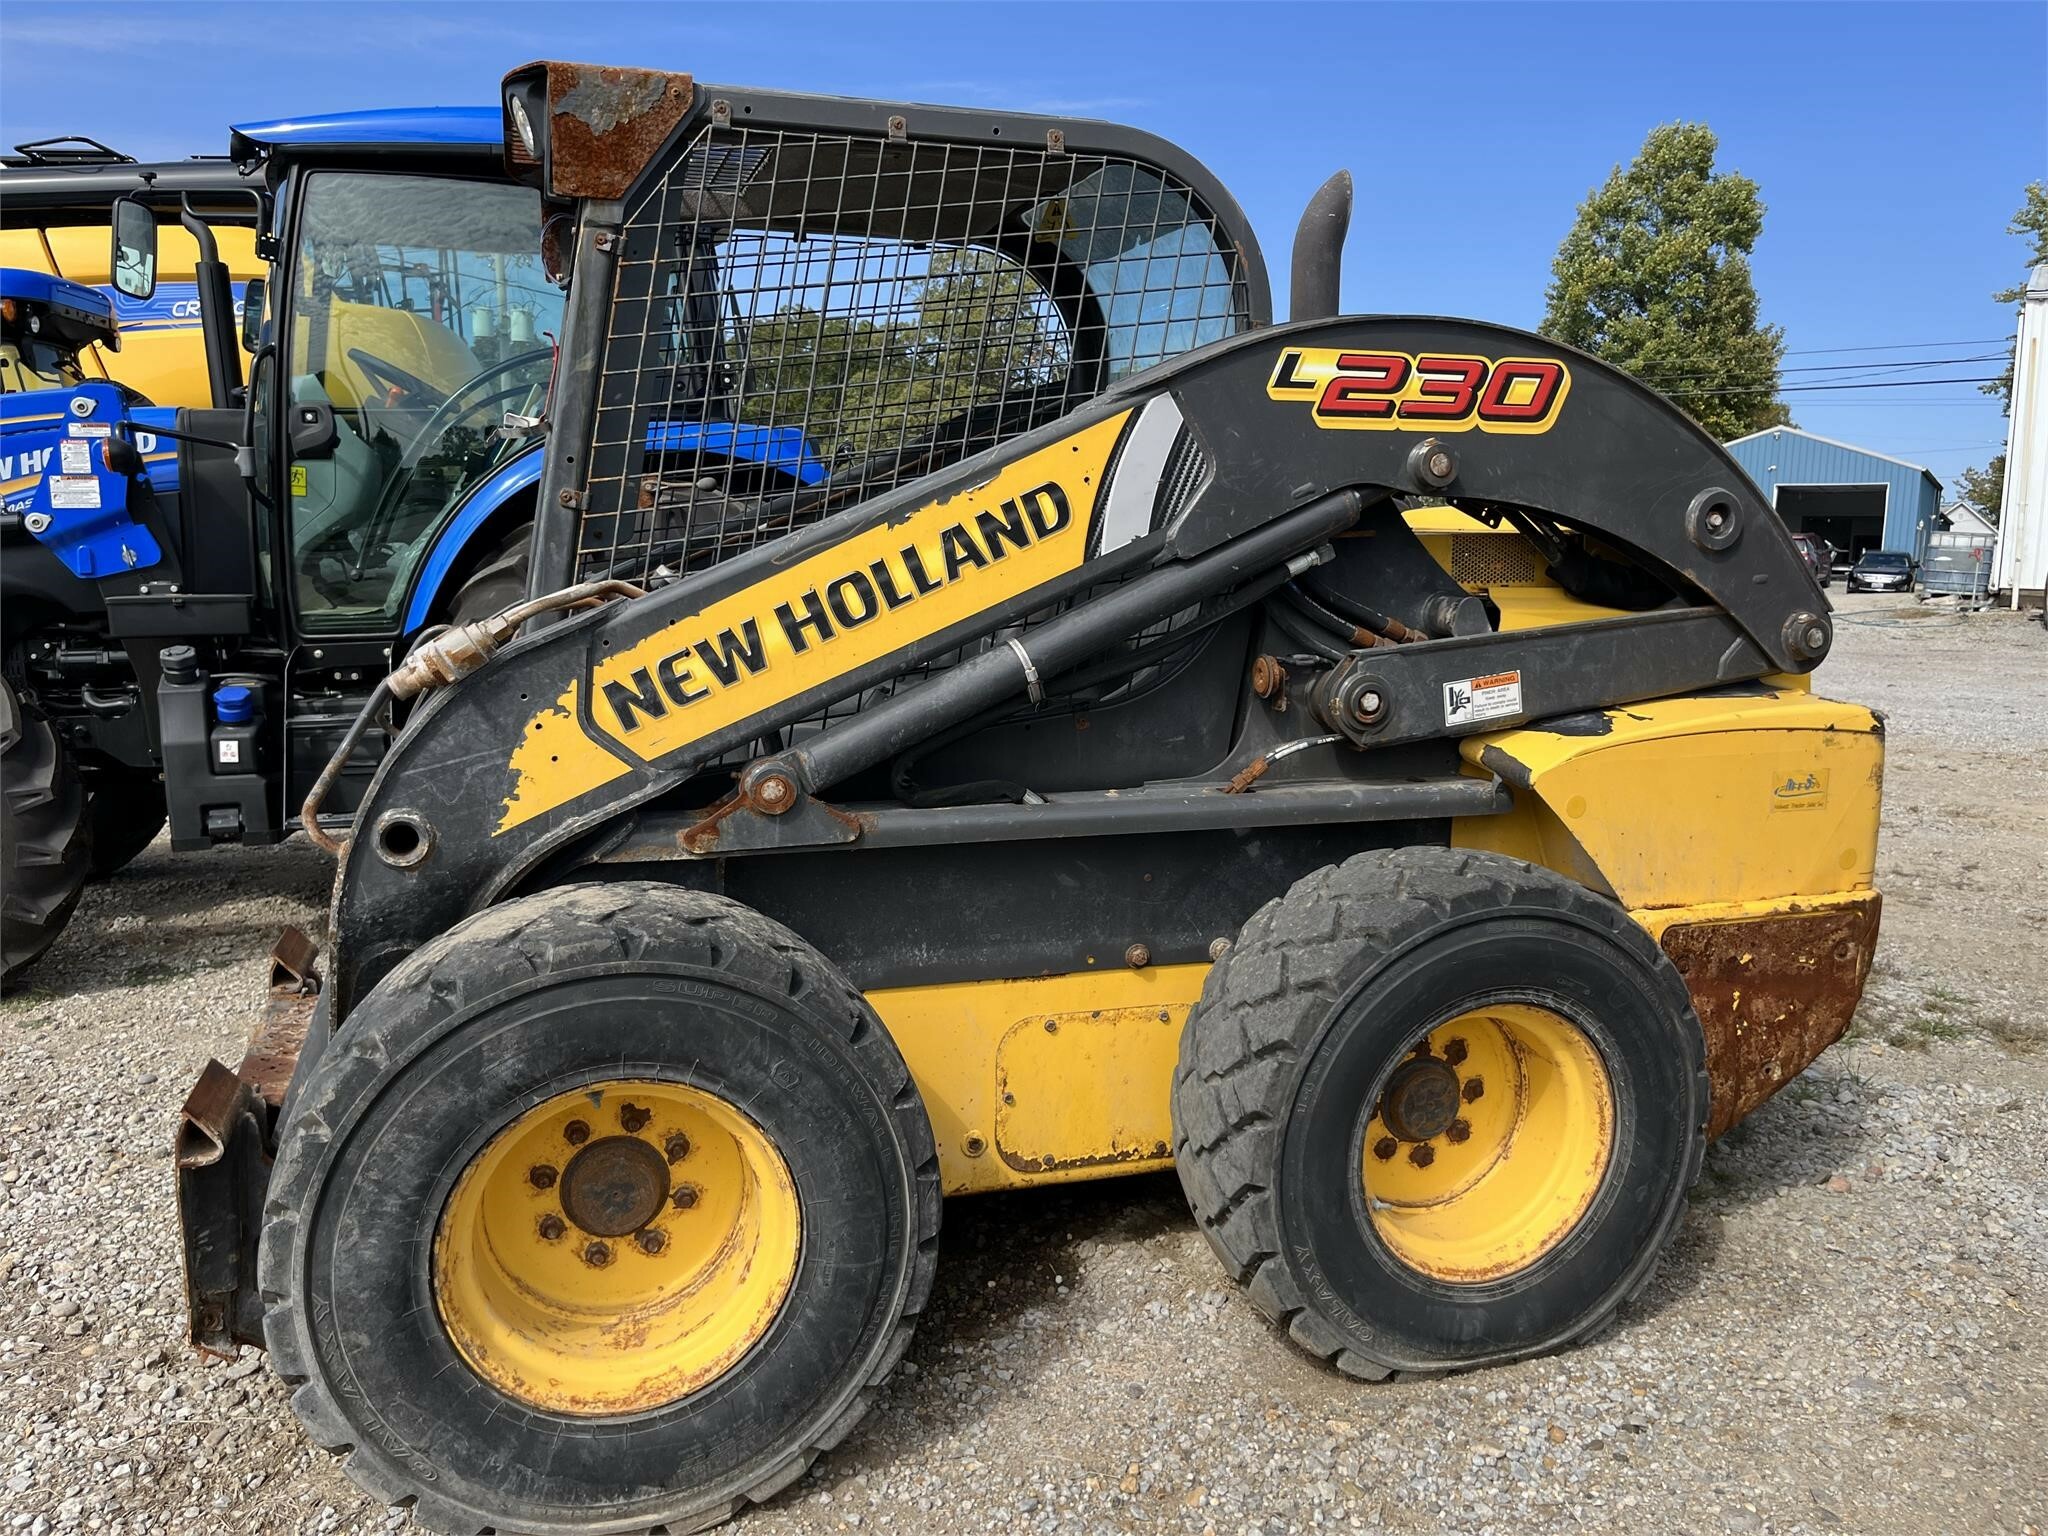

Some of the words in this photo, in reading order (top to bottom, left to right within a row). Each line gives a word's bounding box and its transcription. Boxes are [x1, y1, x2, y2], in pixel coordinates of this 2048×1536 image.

[1268, 349, 1570, 430] L230
[602, 616, 768, 734] NEW
[773, 481, 1072, 655] HOLLAND
[1483, 675, 1516, 686] WARNING
[1293, 1244, 1374, 1341] GALAXY
[312, 1292, 438, 1481] GALAXY
